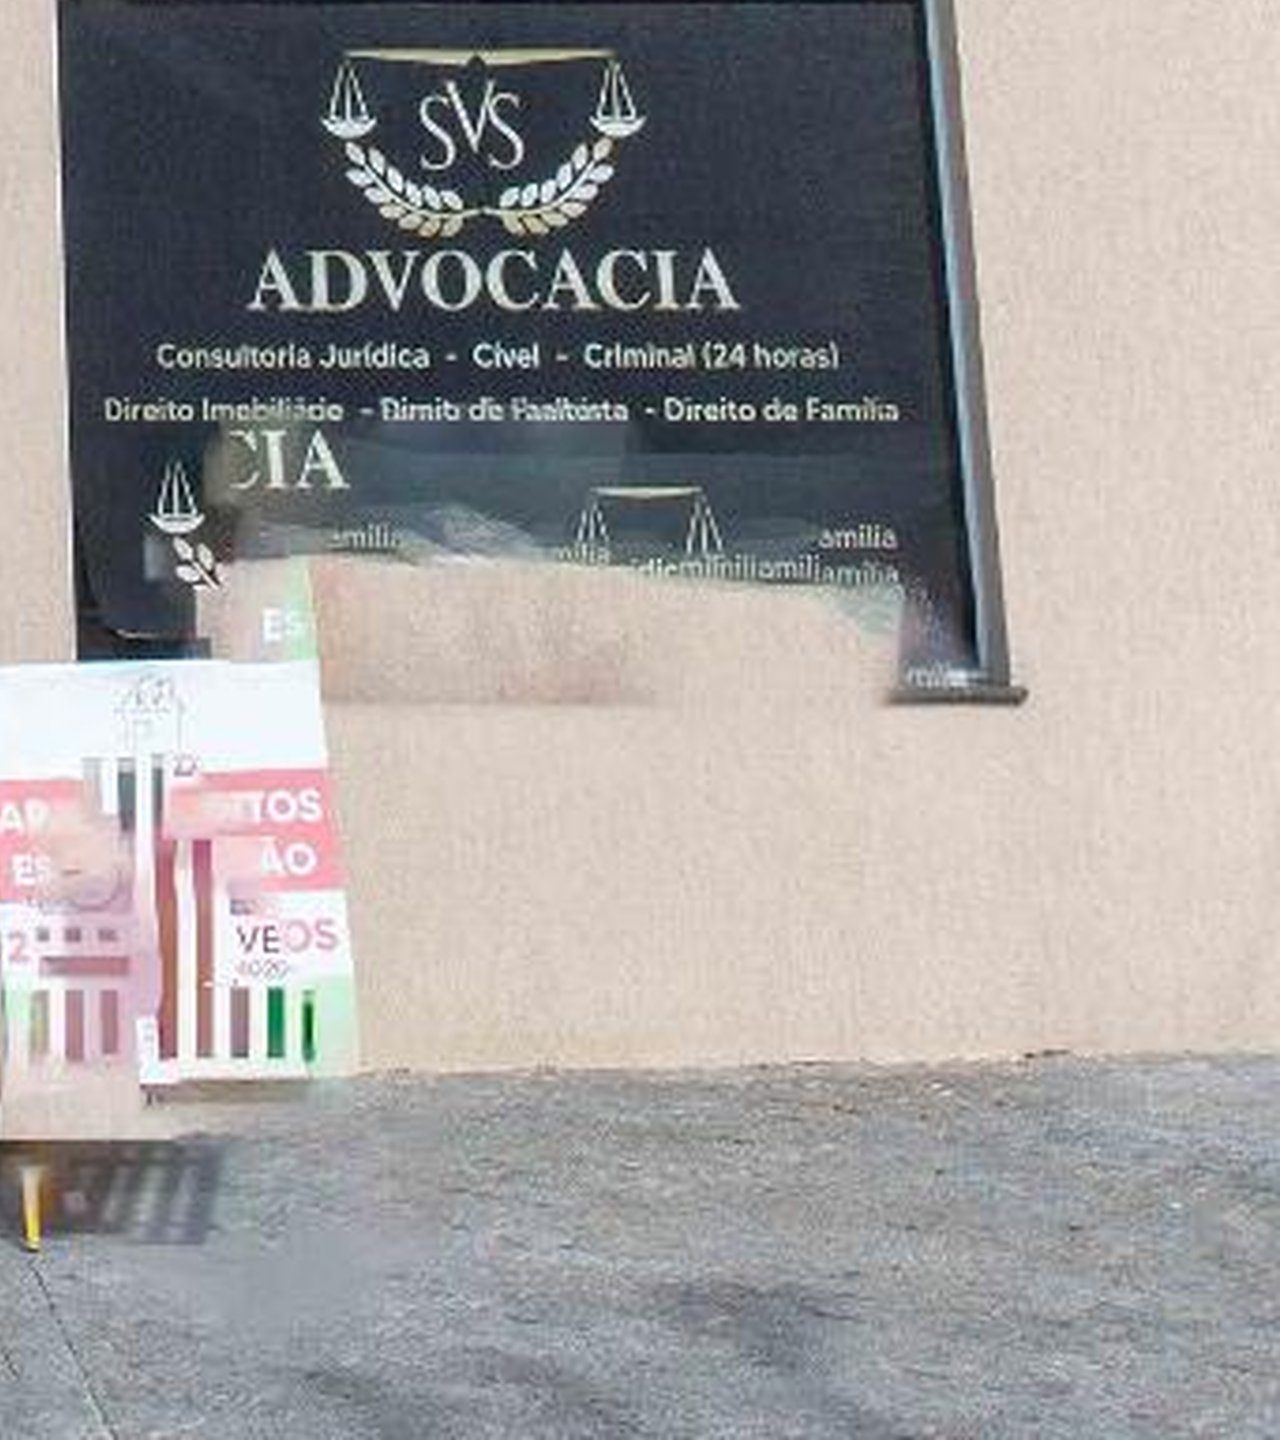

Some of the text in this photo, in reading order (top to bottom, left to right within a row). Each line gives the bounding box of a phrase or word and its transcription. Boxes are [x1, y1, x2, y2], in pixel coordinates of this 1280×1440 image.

[418, 80, 524, 172] SVS
[246, 247, 741, 313] ADVOCACIA
[156, 343, 311, 369] Consultoria
[319, 341, 431, 370] Jurídica
[583, 342, 696, 369] Criminal
[702, 341, 747, 372] (24
[754, 341, 840, 372] horas)
[104, 397, 194, 422] Direito
[663, 397, 755, 422] Direito
[763, 397, 798, 422] de
